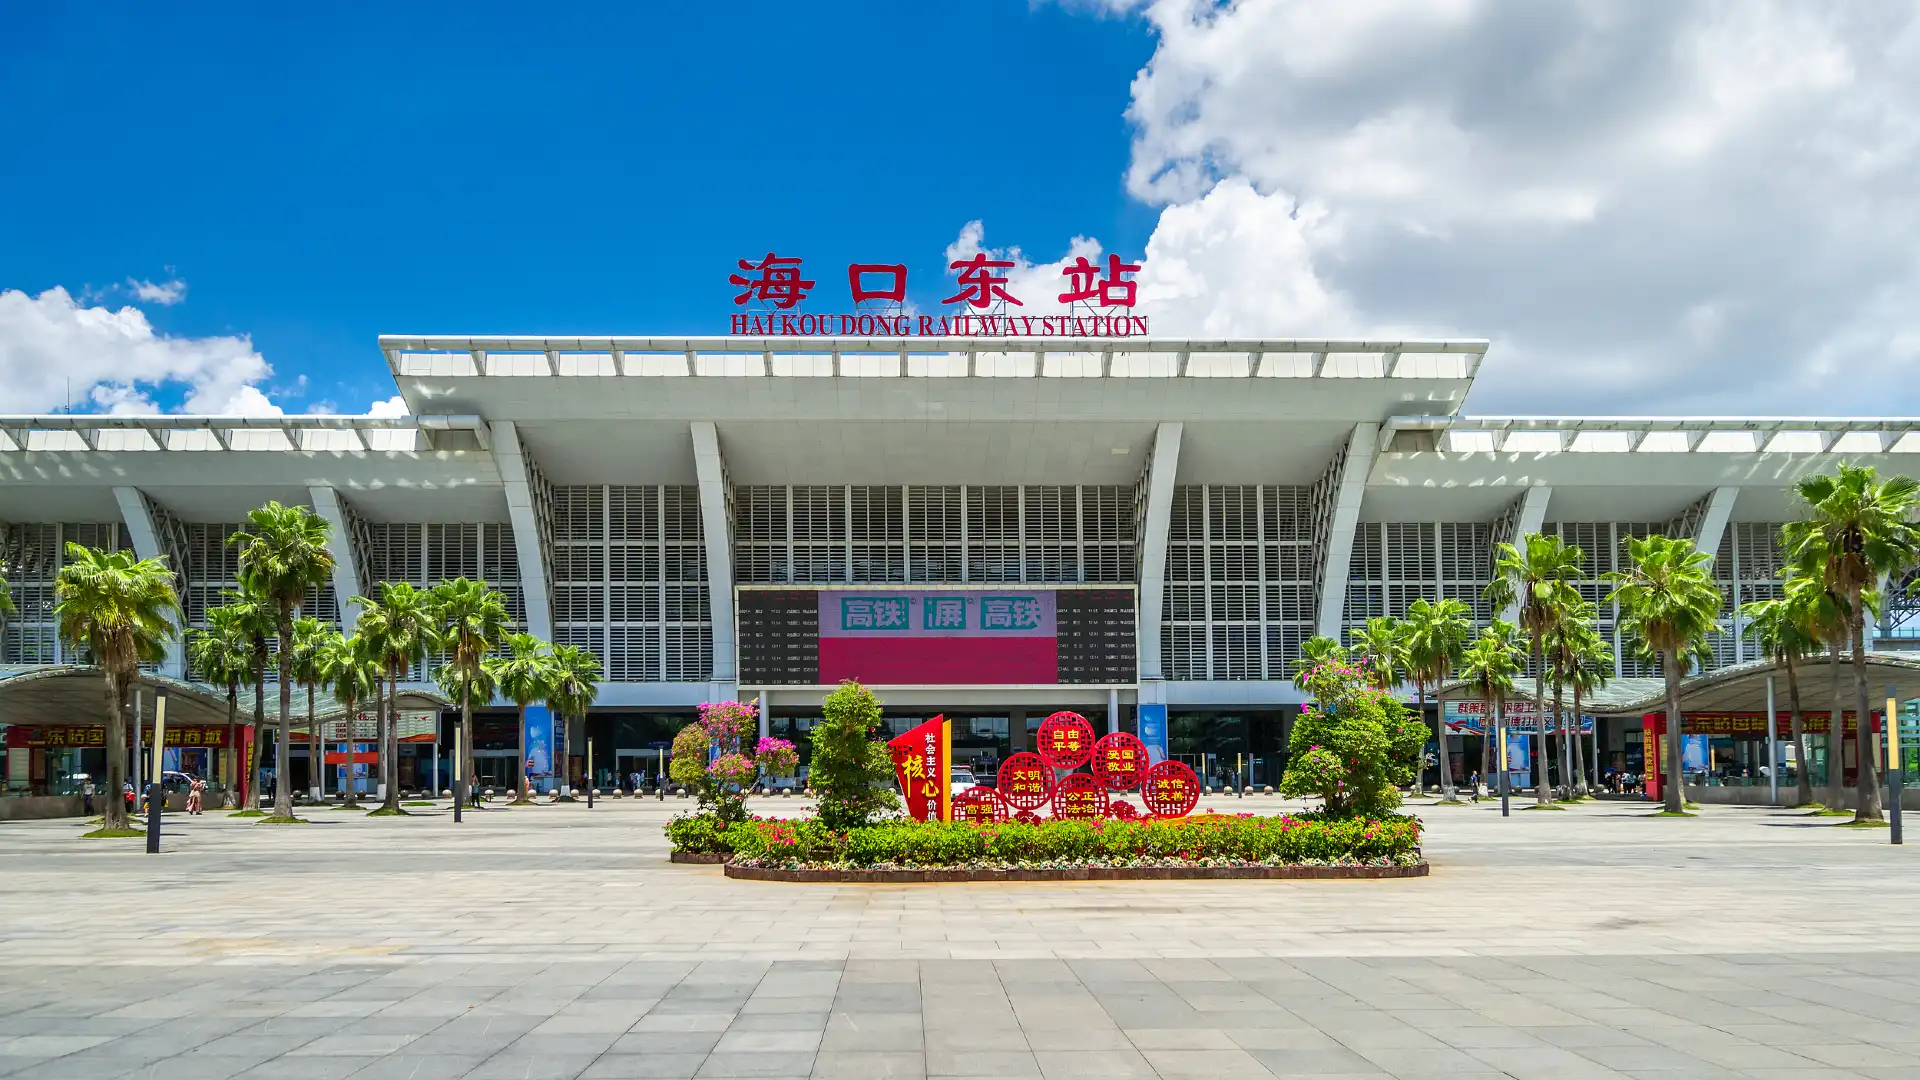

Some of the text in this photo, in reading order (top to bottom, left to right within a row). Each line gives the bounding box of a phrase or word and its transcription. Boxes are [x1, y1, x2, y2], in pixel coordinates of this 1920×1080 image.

[729, 252, 1142, 309] 海口东站
[840, 314, 912, 336] DONG
[918, 315, 1036, 337] RAILWAY
[1042, 315, 1149, 337] STATION
[1053, 729, 1079, 740] 自由
[1052, 741, 1082, 752] 平等
[925, 732, 937, 778] 社会主义
[1107, 749, 1135, 760] 爱国
[1107, 762, 1136, 772] 敬业
[1013, 770, 1041, 781] 文明
[1013, 783, 1041, 793] 和谐
[1157, 778, 1185, 789] 诚信
[1066, 791, 1096, 801] 公正
[1157, 790, 1185, 801] 友善
[965, 804, 993, 815] 富强
[1067, 803, 1095, 814] 法治
